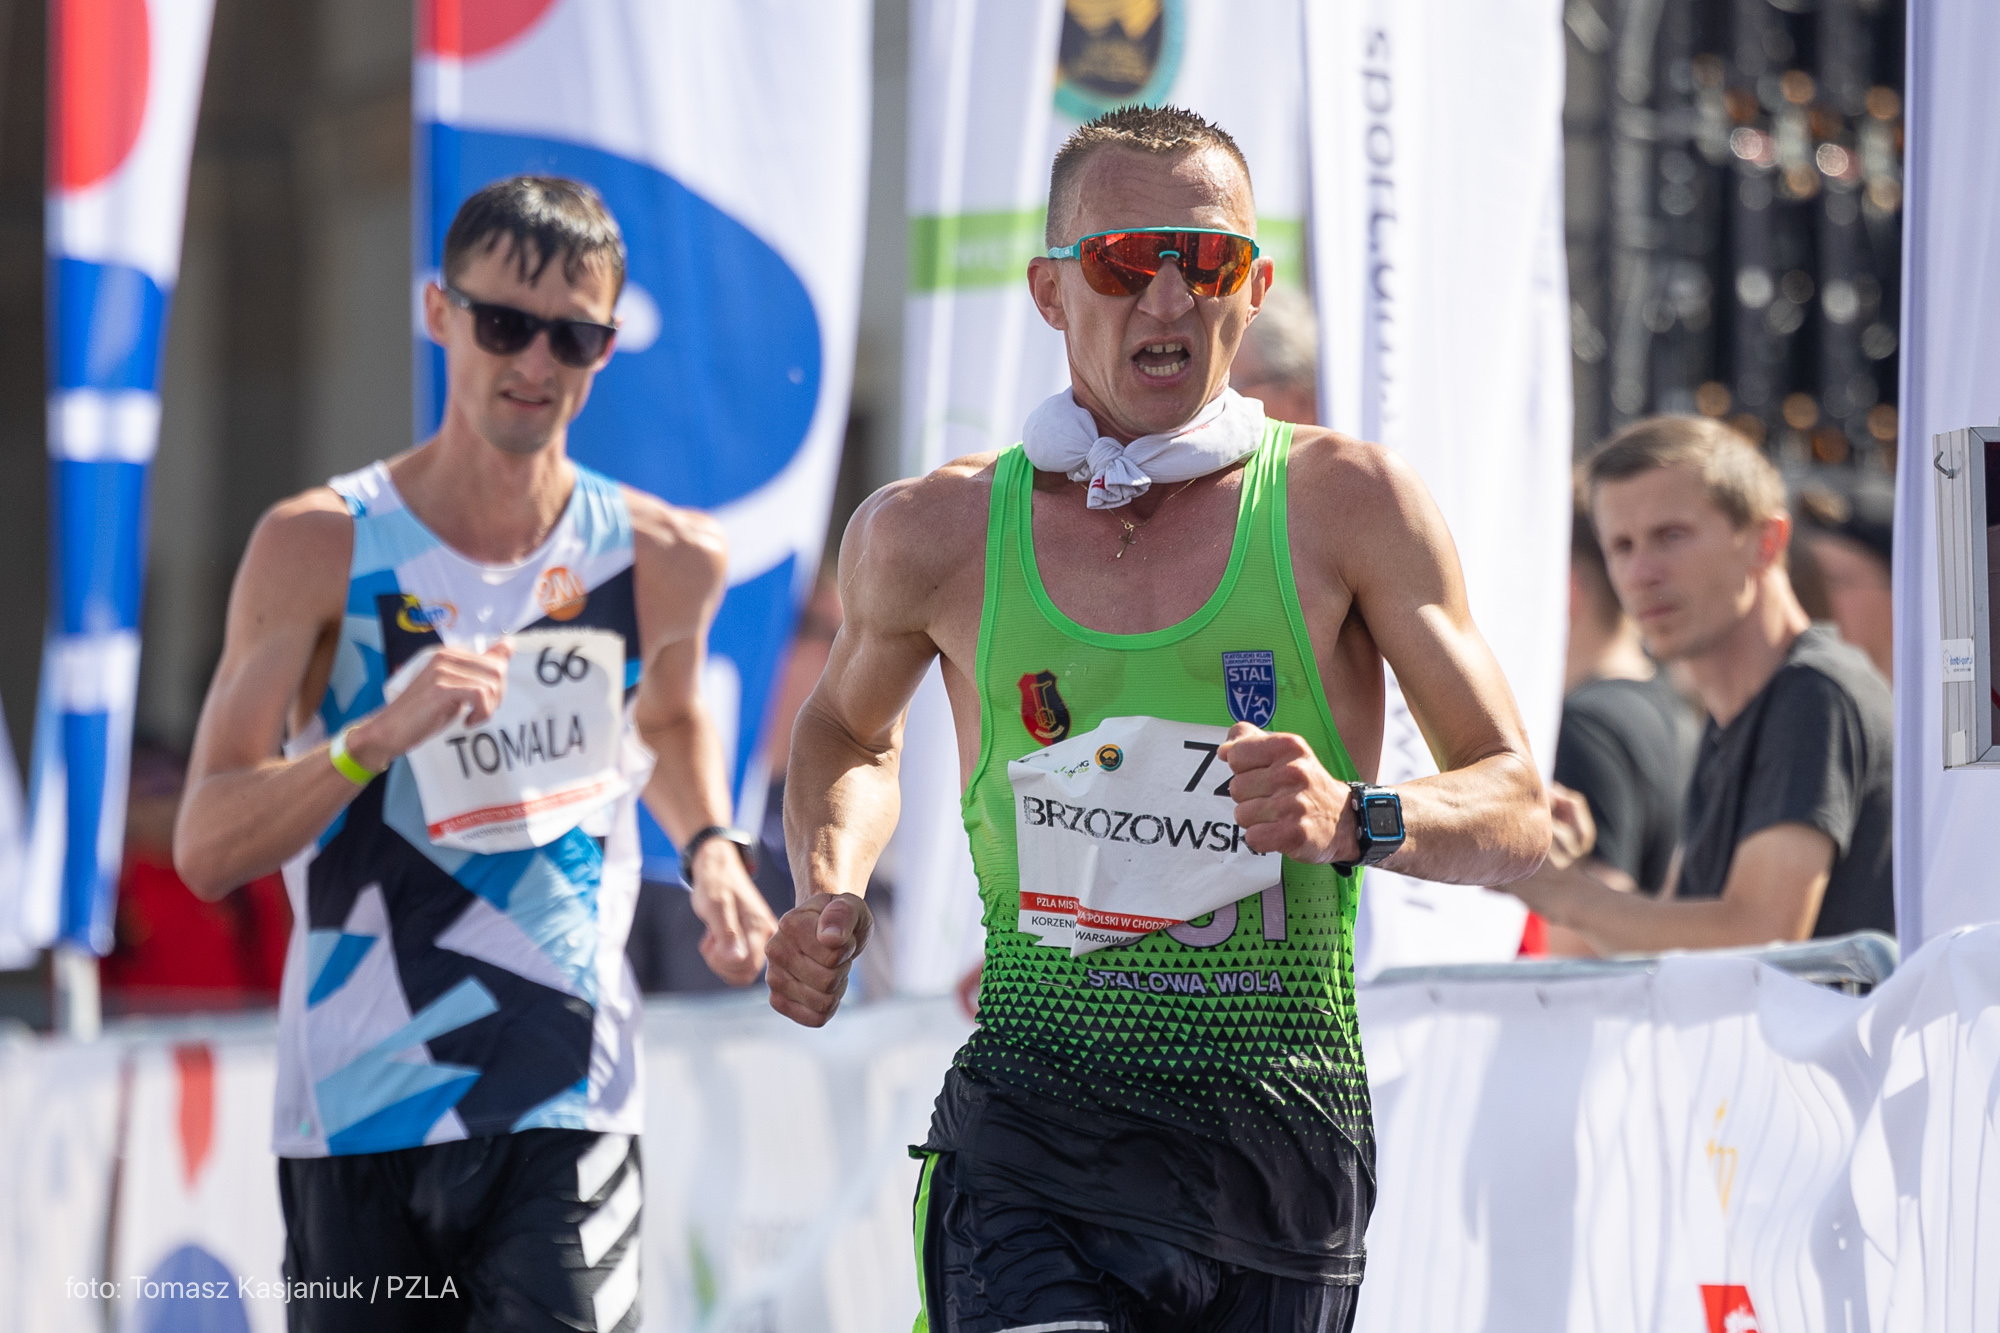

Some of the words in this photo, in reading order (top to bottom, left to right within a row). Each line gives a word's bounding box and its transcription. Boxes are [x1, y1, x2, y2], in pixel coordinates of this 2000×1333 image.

[535, 645, 589, 688] 66
[1228, 667, 1271, 682] STAL
[446, 714, 586, 780] TOMALA
[1183, 740, 1235, 797] 7
[1023, 795, 1267, 857] BRZOZOWSK
[1031, 916, 1077, 929] KORZENI
[1036, 897, 1057, 908] PZLA
[1087, 912, 1119, 926] POLSKI
[1120, 917, 1131, 929] W
[1087, 968, 1207, 994] STALOWA
[1213, 970, 1283, 993] WOLA
